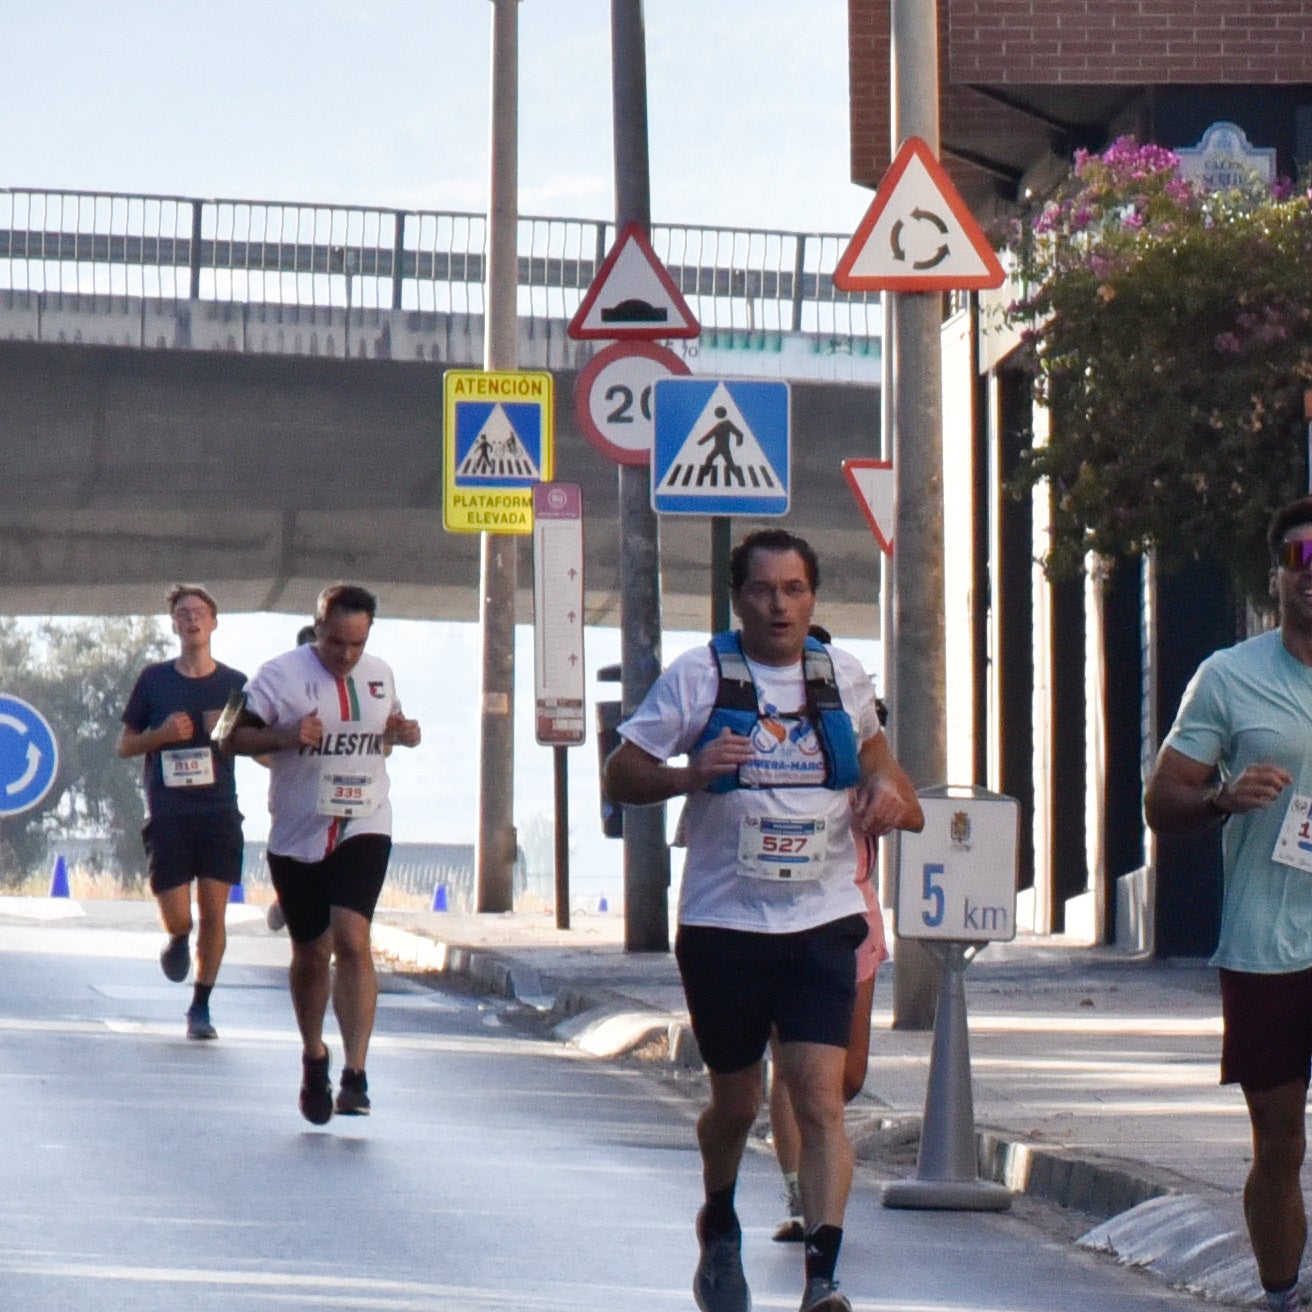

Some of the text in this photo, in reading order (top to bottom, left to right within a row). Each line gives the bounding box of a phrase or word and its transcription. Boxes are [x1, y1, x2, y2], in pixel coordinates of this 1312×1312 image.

[455, 378, 542, 396] ATENCIÓN
[467, 512, 526, 524] ELEVADA
[762, 836, 808, 853] 527
[922, 863, 1008, 931] 5 km
